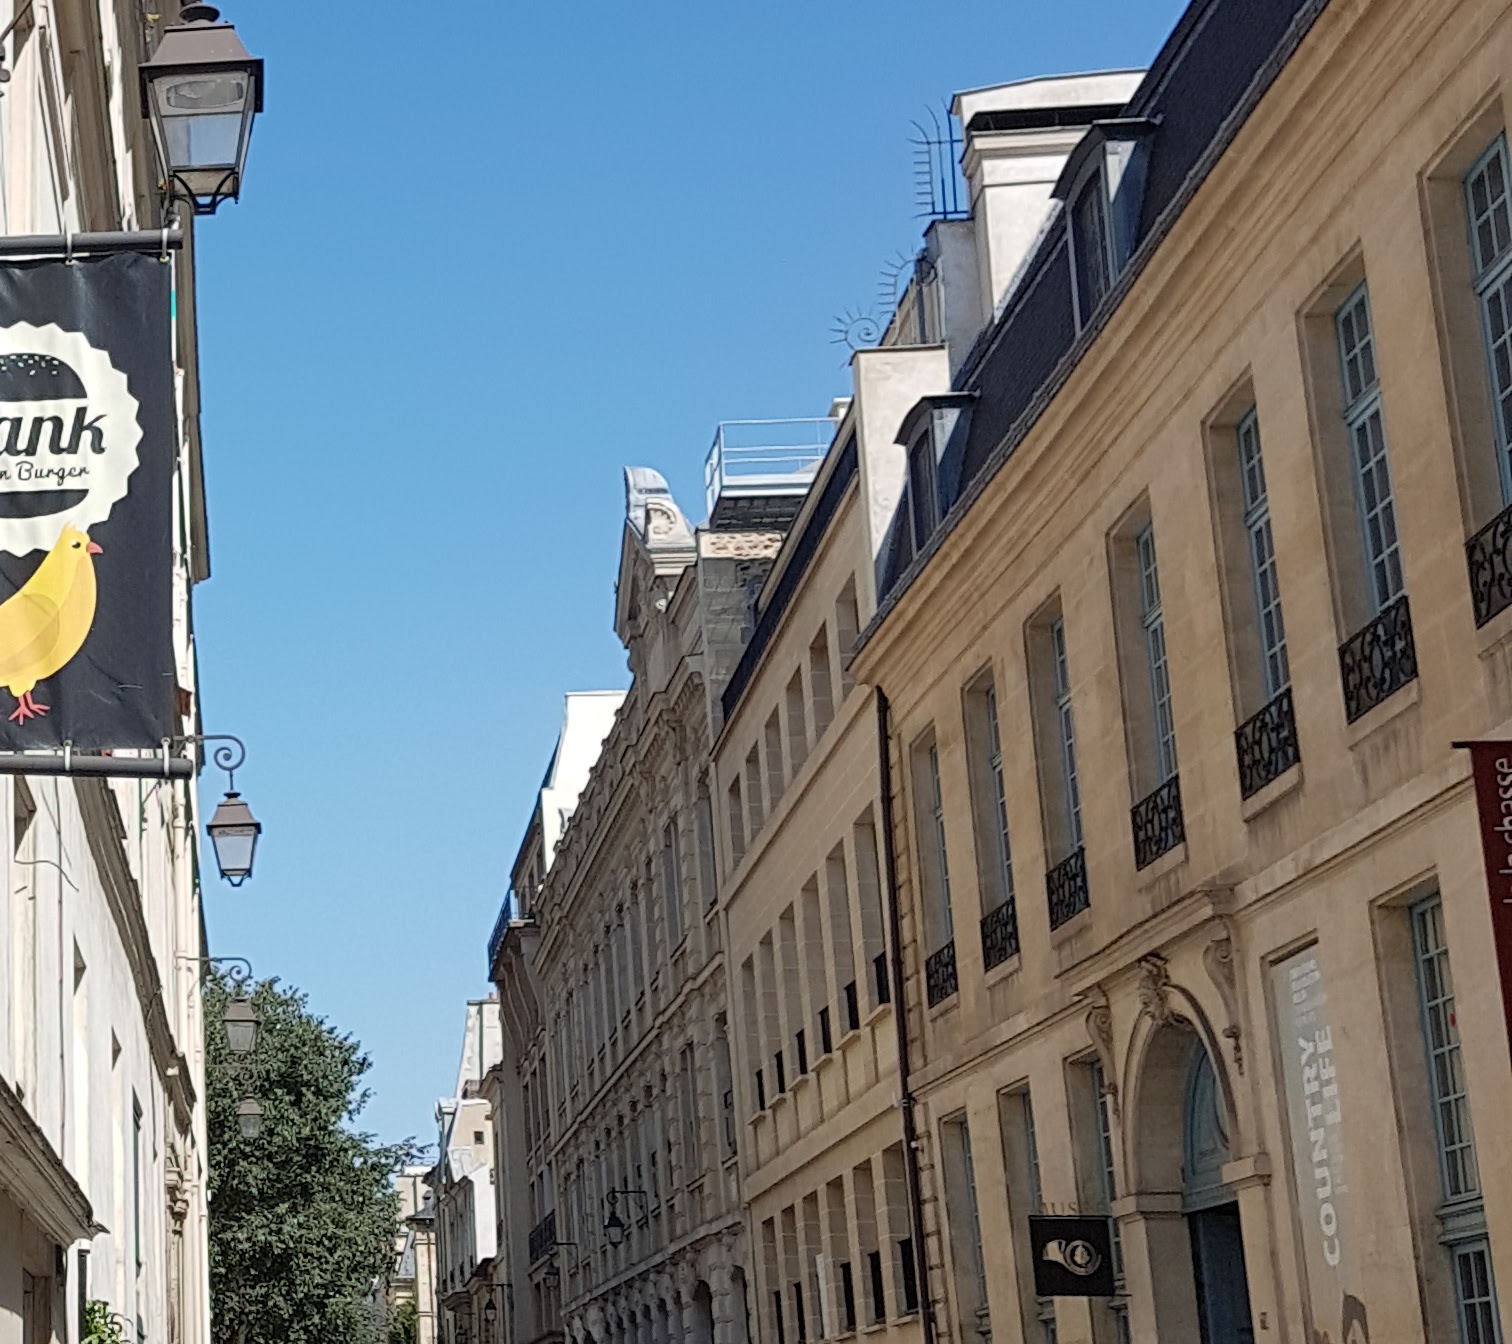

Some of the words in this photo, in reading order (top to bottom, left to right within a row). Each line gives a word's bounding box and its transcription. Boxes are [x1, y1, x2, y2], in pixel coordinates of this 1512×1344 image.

[15, 460, 90, 487] Burger
[1315, 1025, 1342, 1126] LIFE
[1298, 1036, 1342, 1267] COUNTRY
